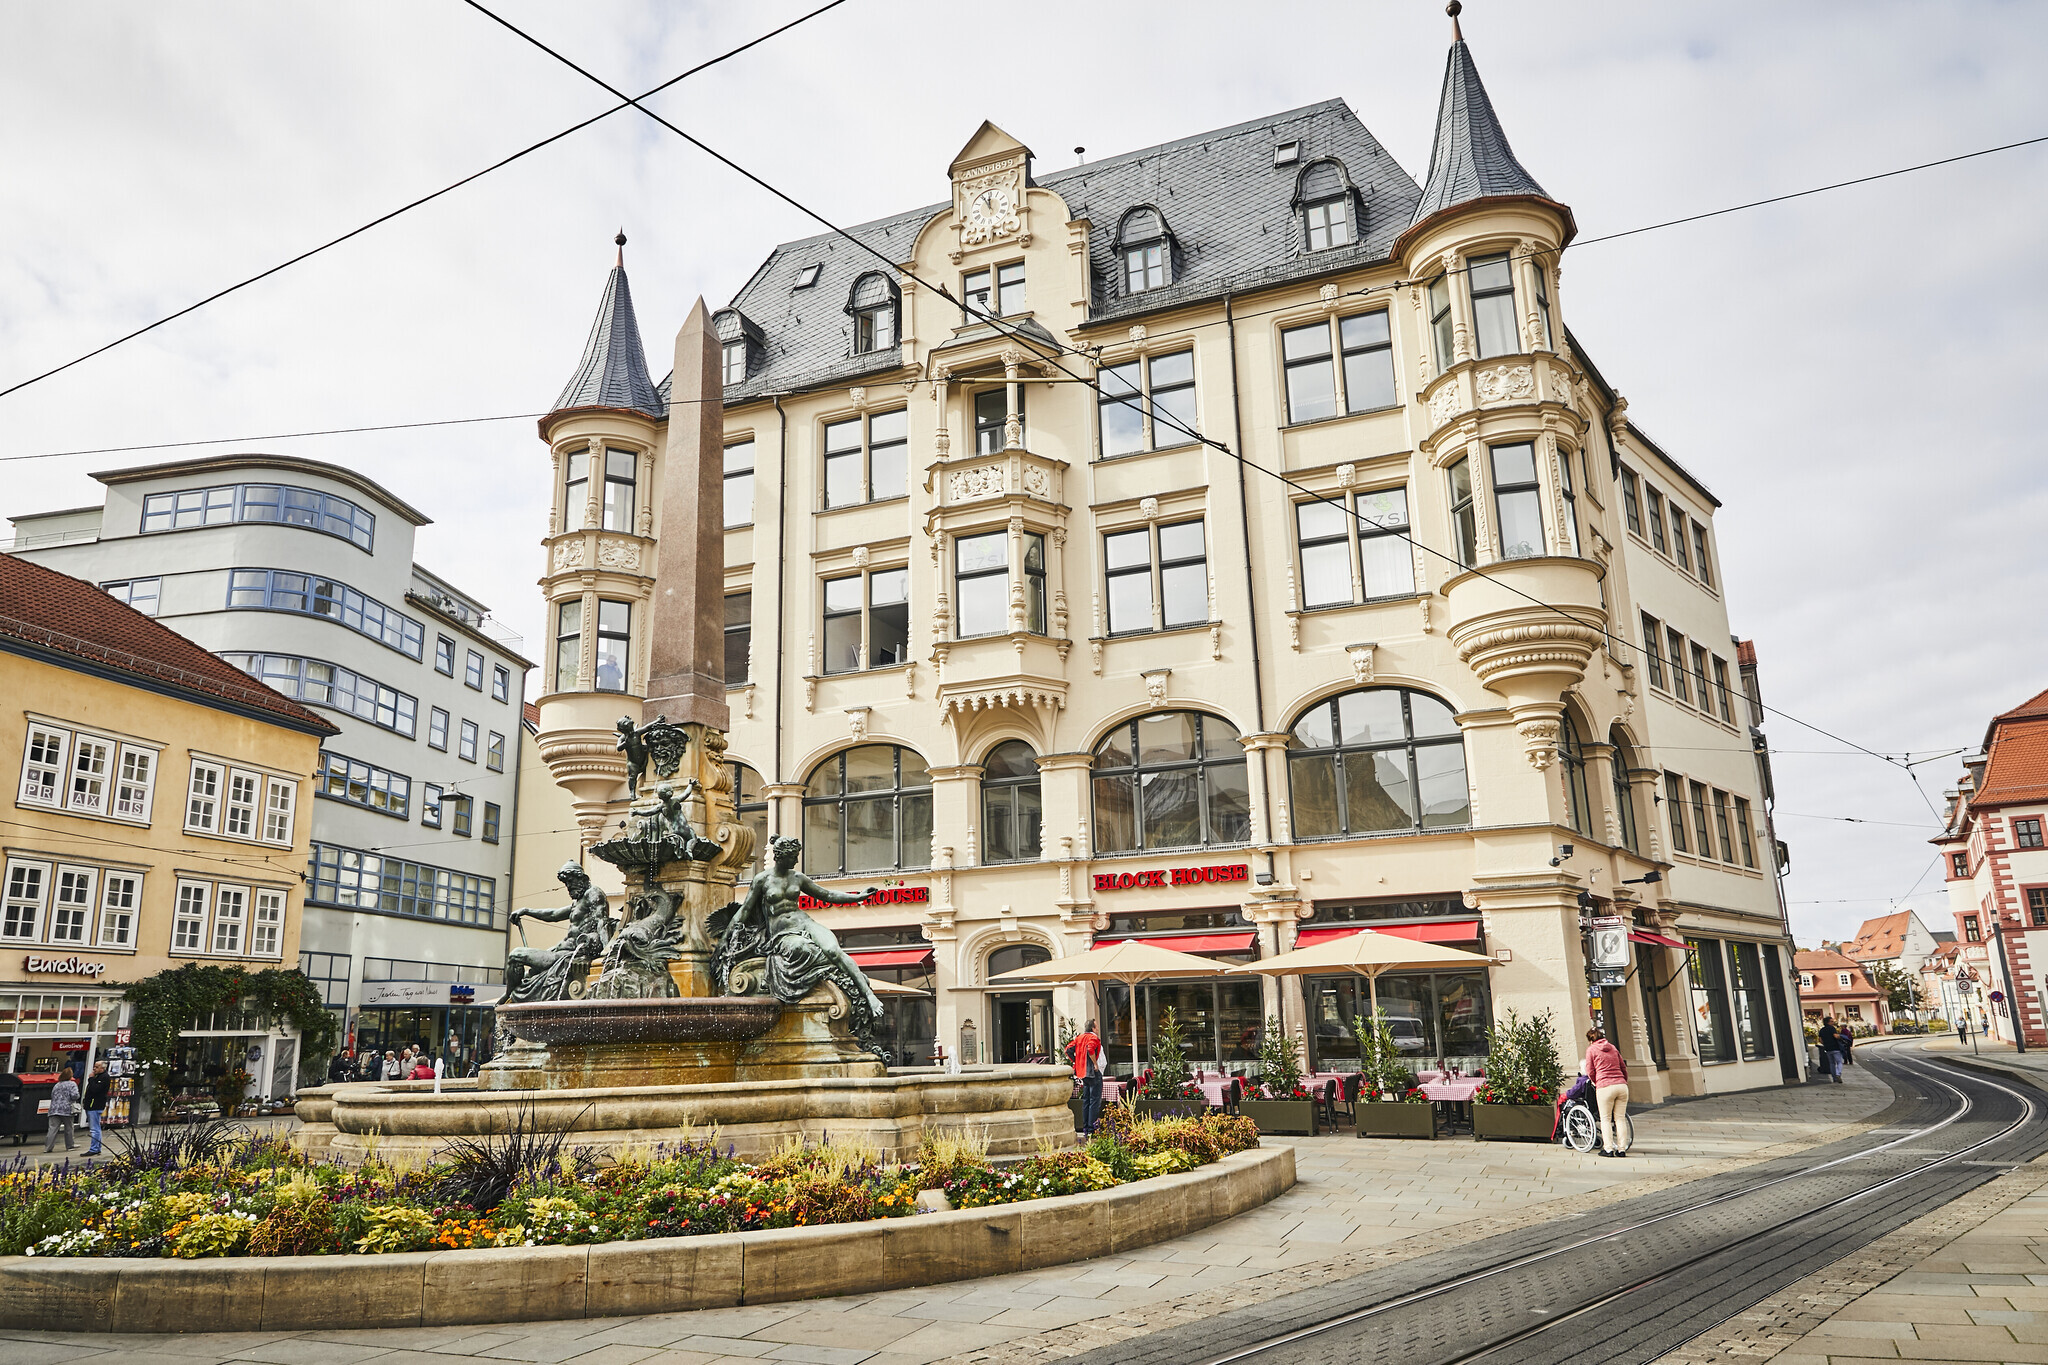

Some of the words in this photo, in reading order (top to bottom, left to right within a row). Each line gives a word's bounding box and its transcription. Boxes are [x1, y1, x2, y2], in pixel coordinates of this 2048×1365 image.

[965, 165, 990, 178] ANNO
[992, 159, 1013, 171] 1899
[1093, 870, 1167, 891] BLOCK
[1169, 864, 1248, 885] HOUSE
[25, 955, 106, 979] EuroShop
